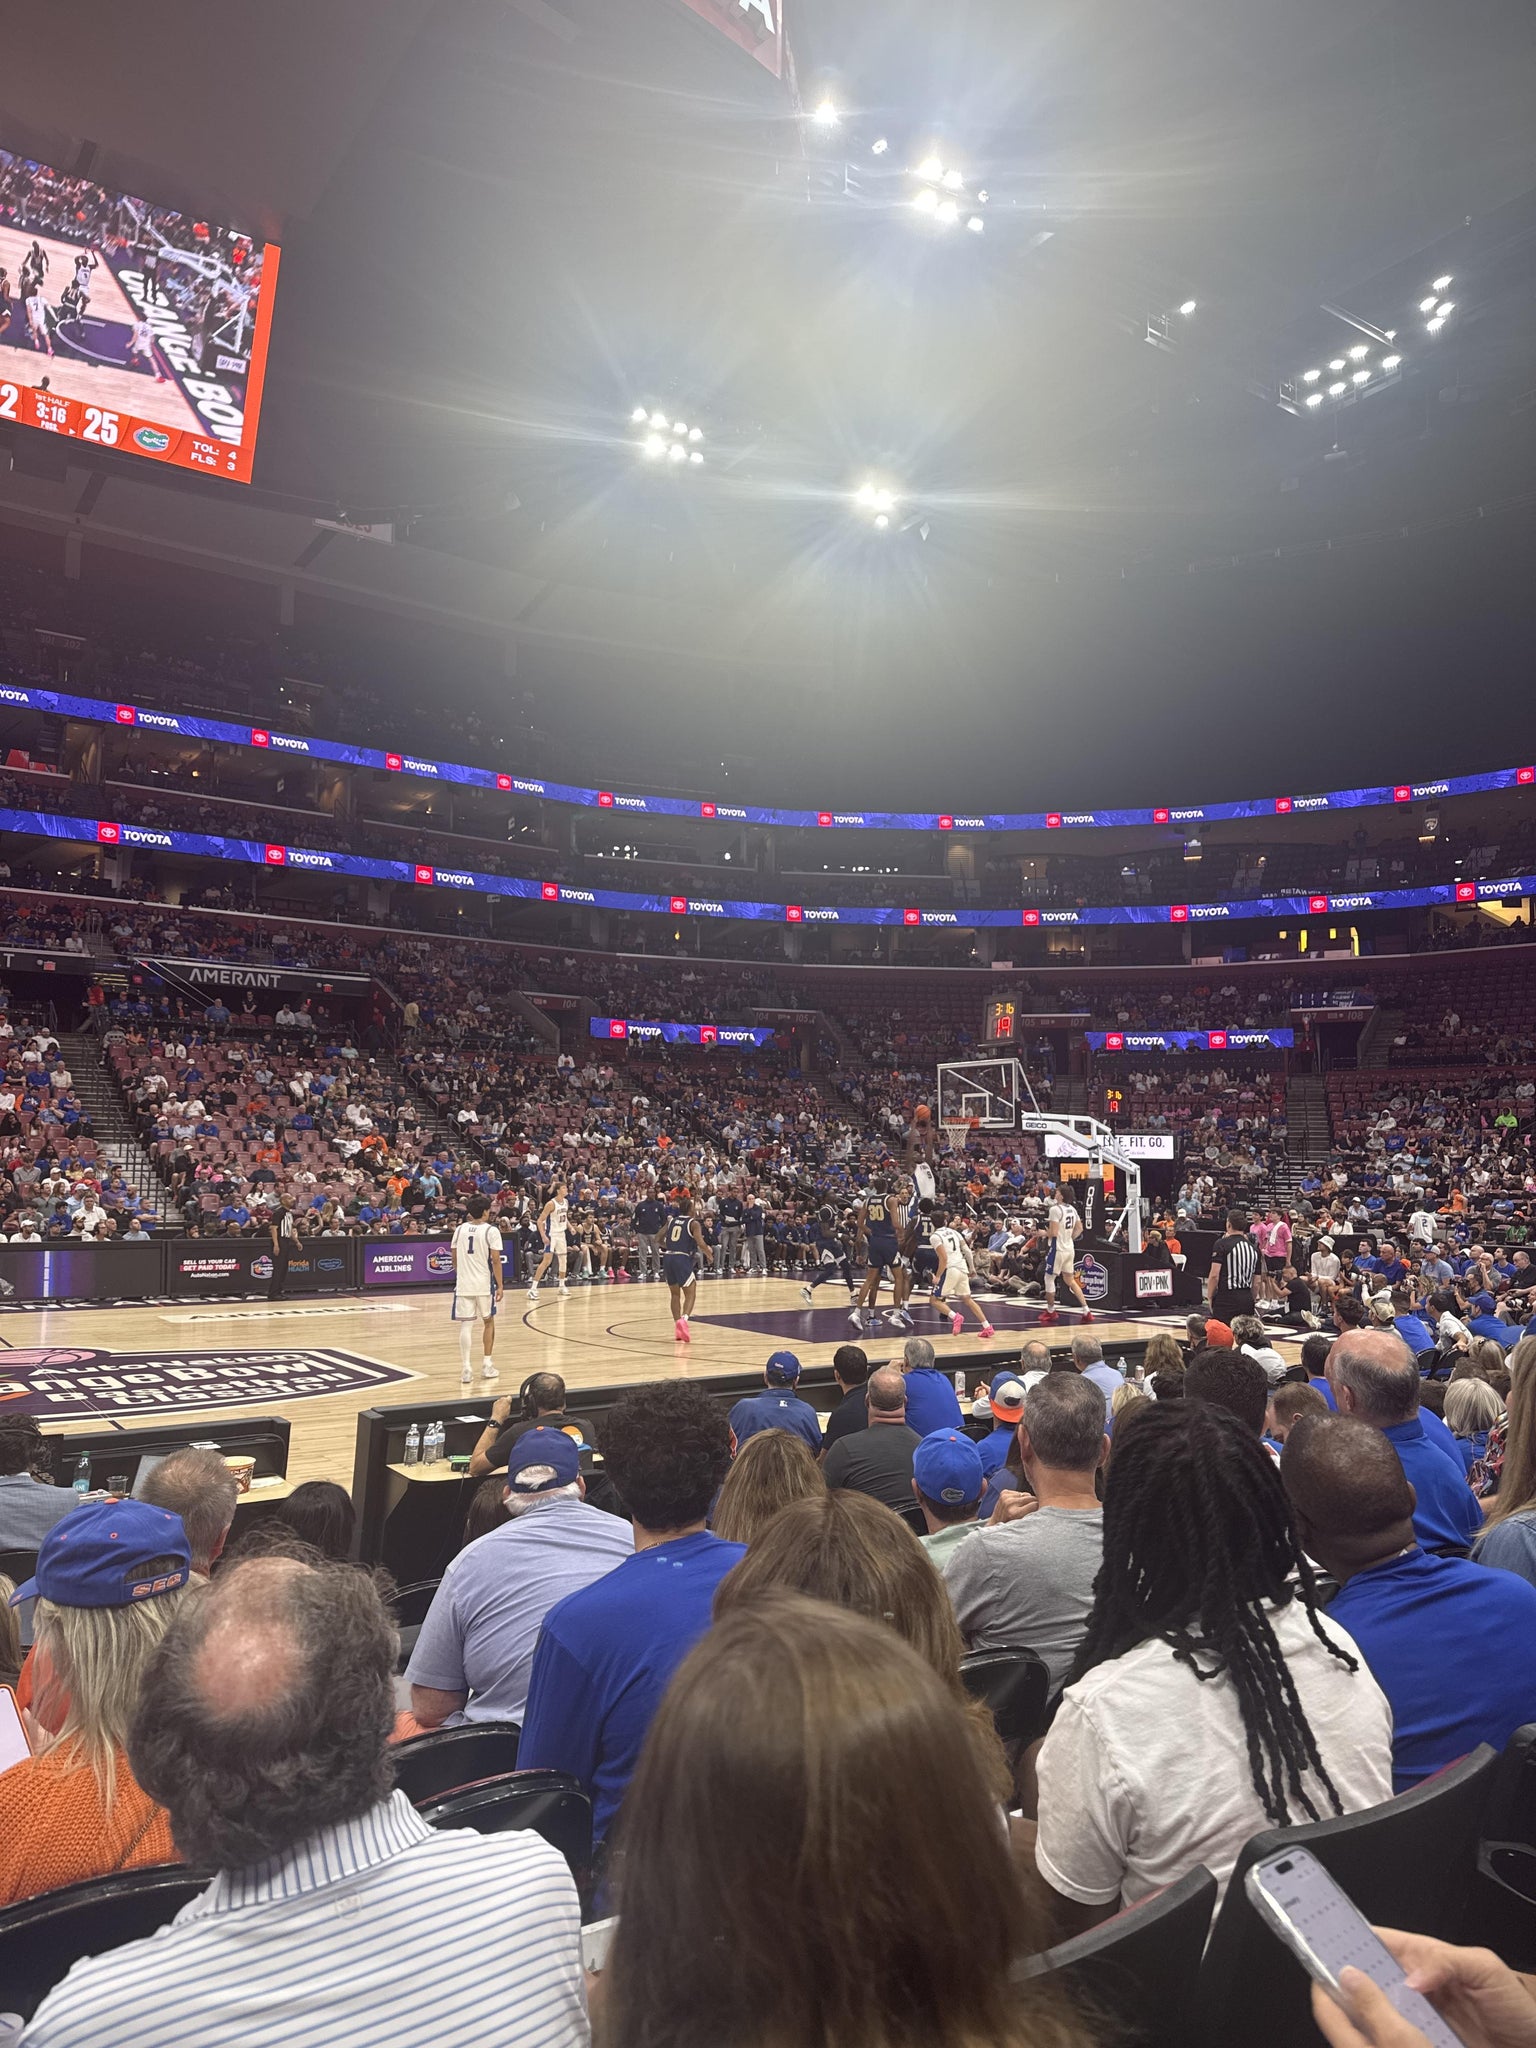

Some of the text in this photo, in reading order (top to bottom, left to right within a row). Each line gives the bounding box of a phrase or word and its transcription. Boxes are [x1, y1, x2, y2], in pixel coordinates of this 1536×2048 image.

[47, 397, 71, 407] HALF
[36, 402, 67, 424] 3:16
[83, 407, 119, 445] 25
[192, 441, 237, 460] TOL: 4
[191, 452, 236, 471] FLS: 3
[138, 713, 179, 728] TOYOTA
[271, 736, 309, 751] TOYOTA
[403, 759, 438, 774] TOYOTA
[513, 780, 544, 793] TOYOTA
[615, 797, 646, 808] TOYOTA
[716, 807, 747, 818] TOYOTA
[834, 815, 864, 824] TOYOTA
[954, 819, 985, 827] TOYOTA
[1062, 815, 1094, 824] TOYOTA
[1170, 810, 1204, 819] TOYOTA
[1294, 798, 1328, 808] TOYOTA
[1412, 784, 1449, 796] TOYOTA
[123, 830, 1523, 922] TOYOTA TOYOTA TOYOTA TOYOTA TOYOTA TOYOTA TOYOTA TOYOTA TOYOTA TOYOTA TOYOTA
[189, 968, 281, 988] AMERANT
[995, 1002, 1015, 1016] 3:16
[1126, 1034, 1270, 1046] TOYOTA TOYOTA
[1107, 1089, 1122, 1100] 3:16
[1110, 1100, 1119, 1113] 19
[1130, 1136, 1146, 1148] FIT.
[1149, 1136, 1165, 1148] GO.
[868, 1204, 885, 1221] 30
[1084, 1186, 1096, 1230] GEICO
[1065, 1215, 1075, 1230] 21
[1421, 1218, 1428, 1228] 2
[670, 1225, 683, 1242] 0
[467, 1235, 475, 1255] 1
[947, 1236, 956, 1252] 7
[372, 1255, 414, 1264] AMERICAN
[375, 1264, 412, 1273] AIRLINES
[1138, 1275, 1170, 1291] DRV PNK
[189, 1305, 394, 1321] AutoNation
[28, 1353, 308, 1377] AutoNation
[45, 1371, 354, 1403] Basketball
[113, 1383, 329, 1406] Classic
[132, 1573, 182, 1597] SEC
